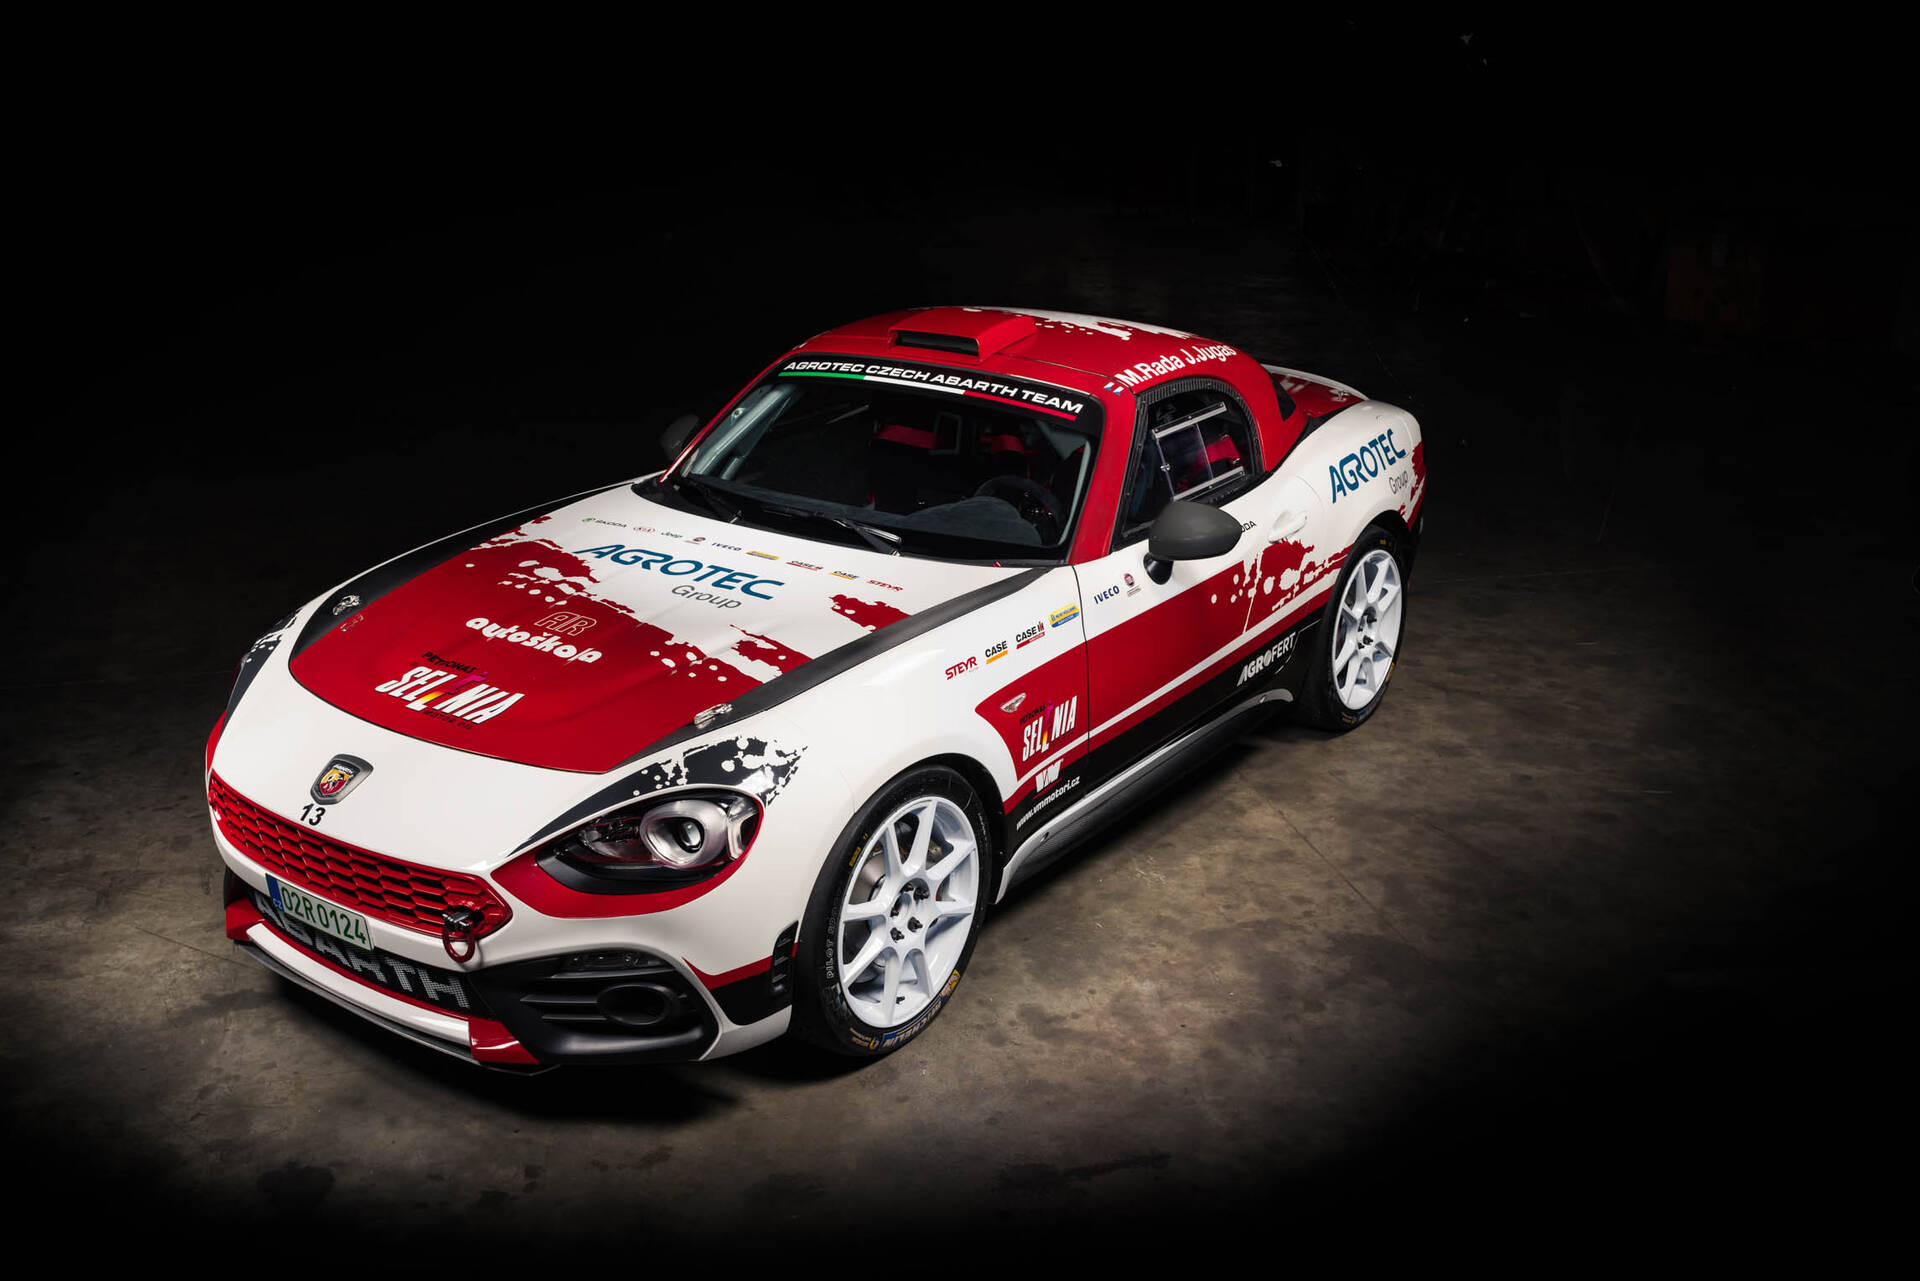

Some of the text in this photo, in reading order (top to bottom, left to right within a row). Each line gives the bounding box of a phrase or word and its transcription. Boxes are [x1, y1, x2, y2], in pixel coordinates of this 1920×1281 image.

[1115, 343, 1237, 388] M.Rada J.Jugas
[783, 361, 1084, 414] AGROTEC CZECH ABARTH TEAM
[1329, 428, 1407, 504] AGROTEC
[1388, 470, 1408, 495] Group
[711, 541, 742, 552] IVECO
[572, 543, 785, 600] AGROTEC
[671, 585, 742, 609] Group
[866, 579, 904, 592] STEYR
[1093, 585, 1120, 604] IVECO
[1015, 626, 1037, 643] CASE
[985, 640, 1008, 659] CASE
[1237, 632, 1296, 687] AGROFERT
[945, 656, 978, 680] STEYR
[299, 803, 326, 826] 13
[1016, 776, 1080, 831] www.vmmotori.cz
